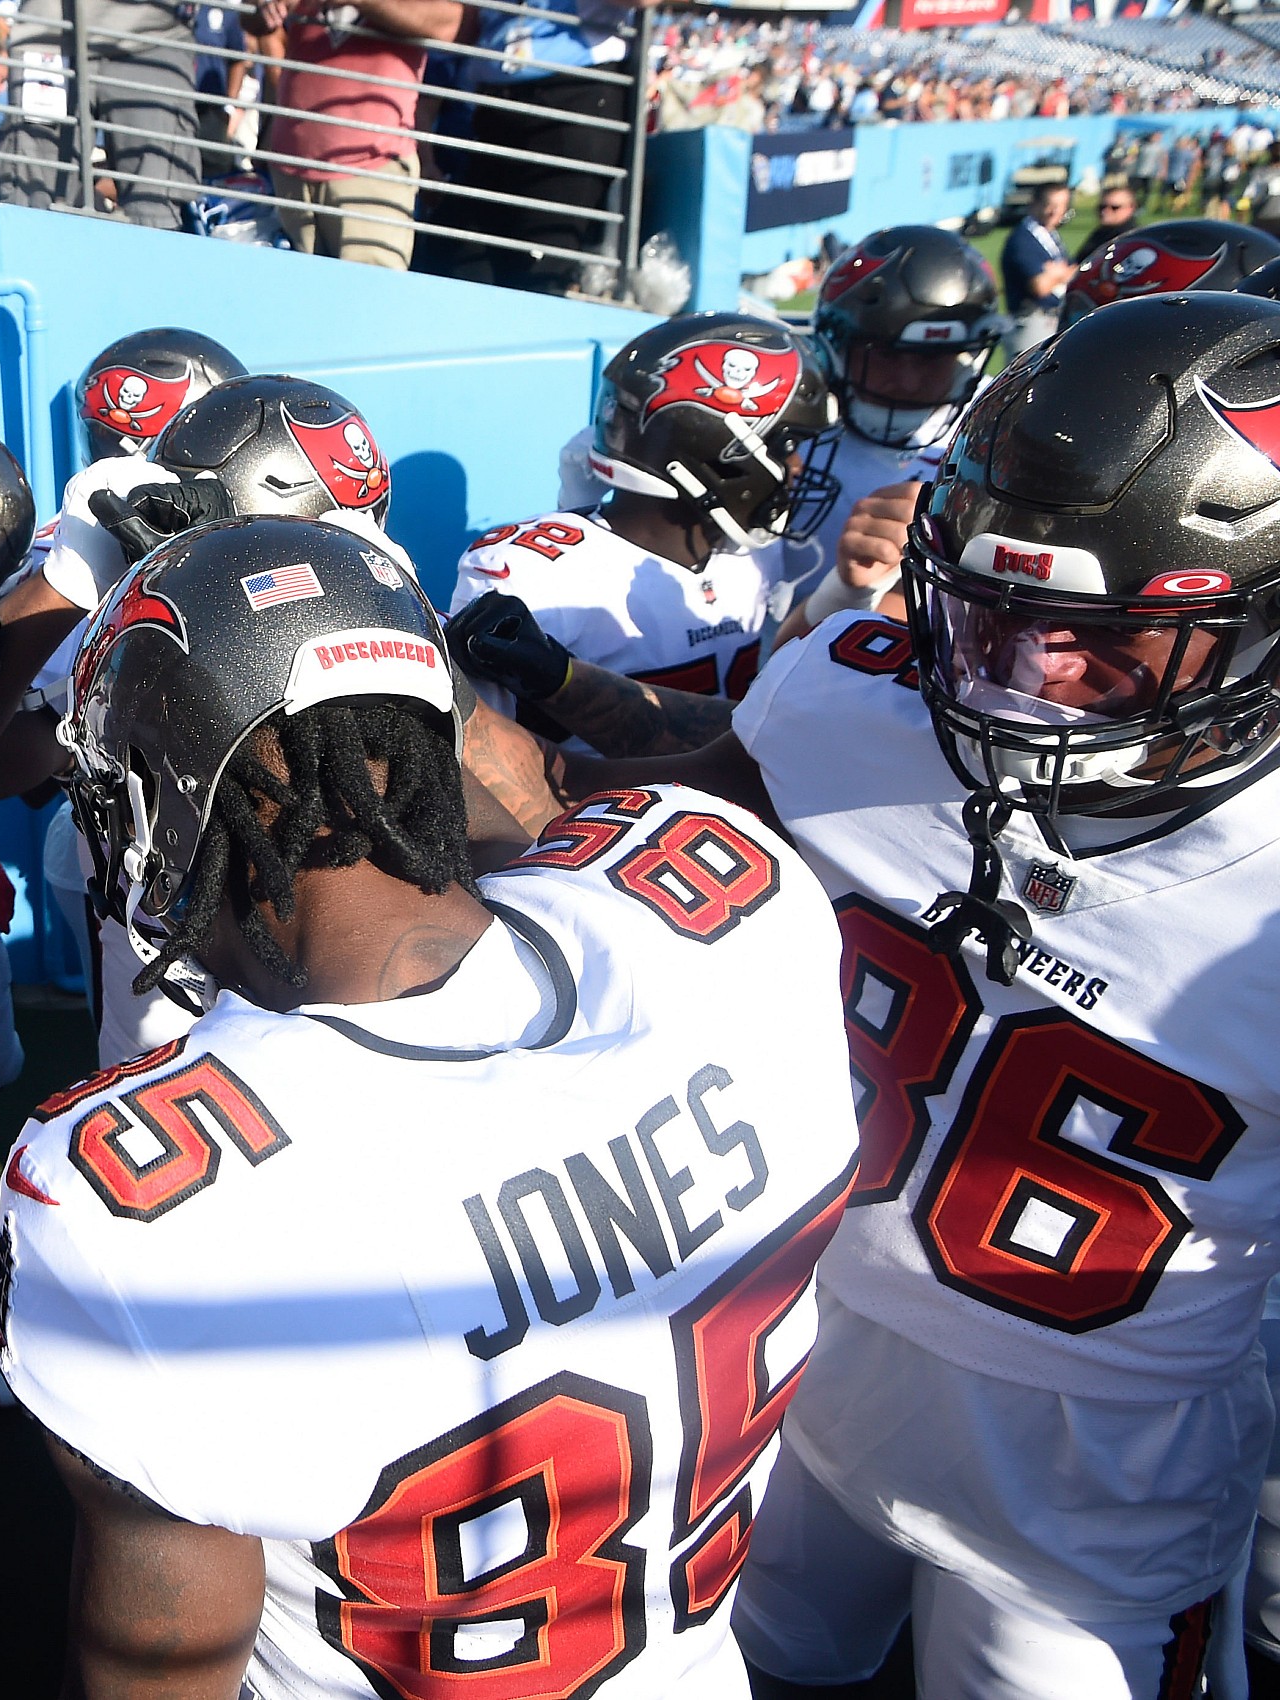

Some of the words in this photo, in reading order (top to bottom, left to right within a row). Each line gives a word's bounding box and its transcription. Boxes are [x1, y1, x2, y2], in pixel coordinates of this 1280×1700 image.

[993, 543, 1055, 581] BUCS
[313, 640, 436, 670] BUCCANEERS
[1025, 878, 1060, 909] NFL
[830, 891, 1248, 1335] 86
[462, 1063, 769, 1361] JONES
[314, 1157, 860, 1700] 85
